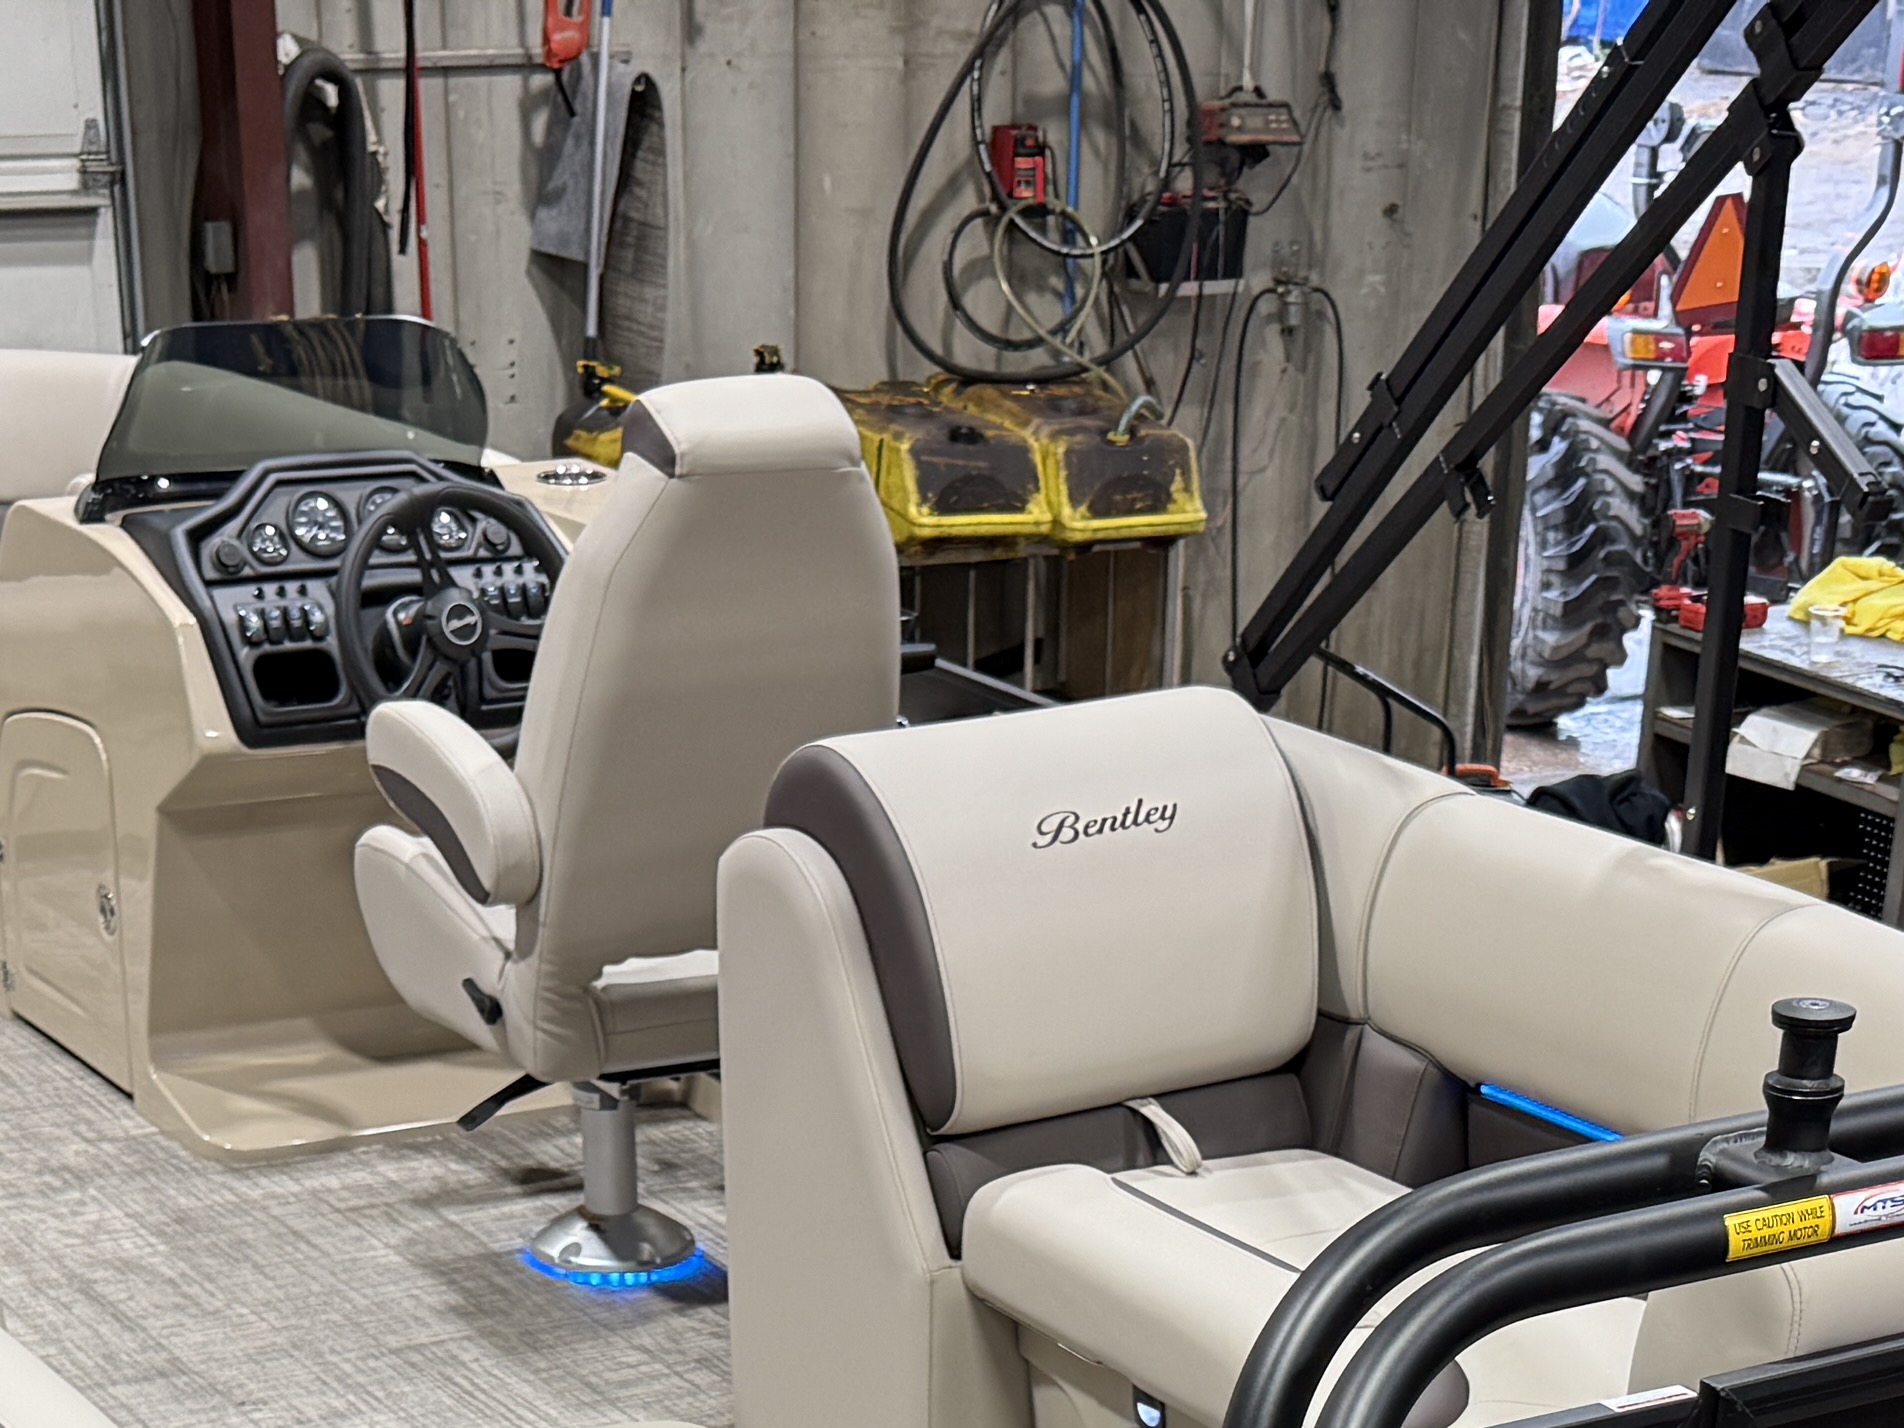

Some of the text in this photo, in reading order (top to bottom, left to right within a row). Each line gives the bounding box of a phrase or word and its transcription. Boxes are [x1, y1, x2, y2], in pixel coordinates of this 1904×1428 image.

[1031, 797, 1178, 849] Bentley
[1734, 1205, 1825, 1235] USE CAUTION WHILE
[1741, 1224, 1819, 1251] TRIMMING MOTOR
